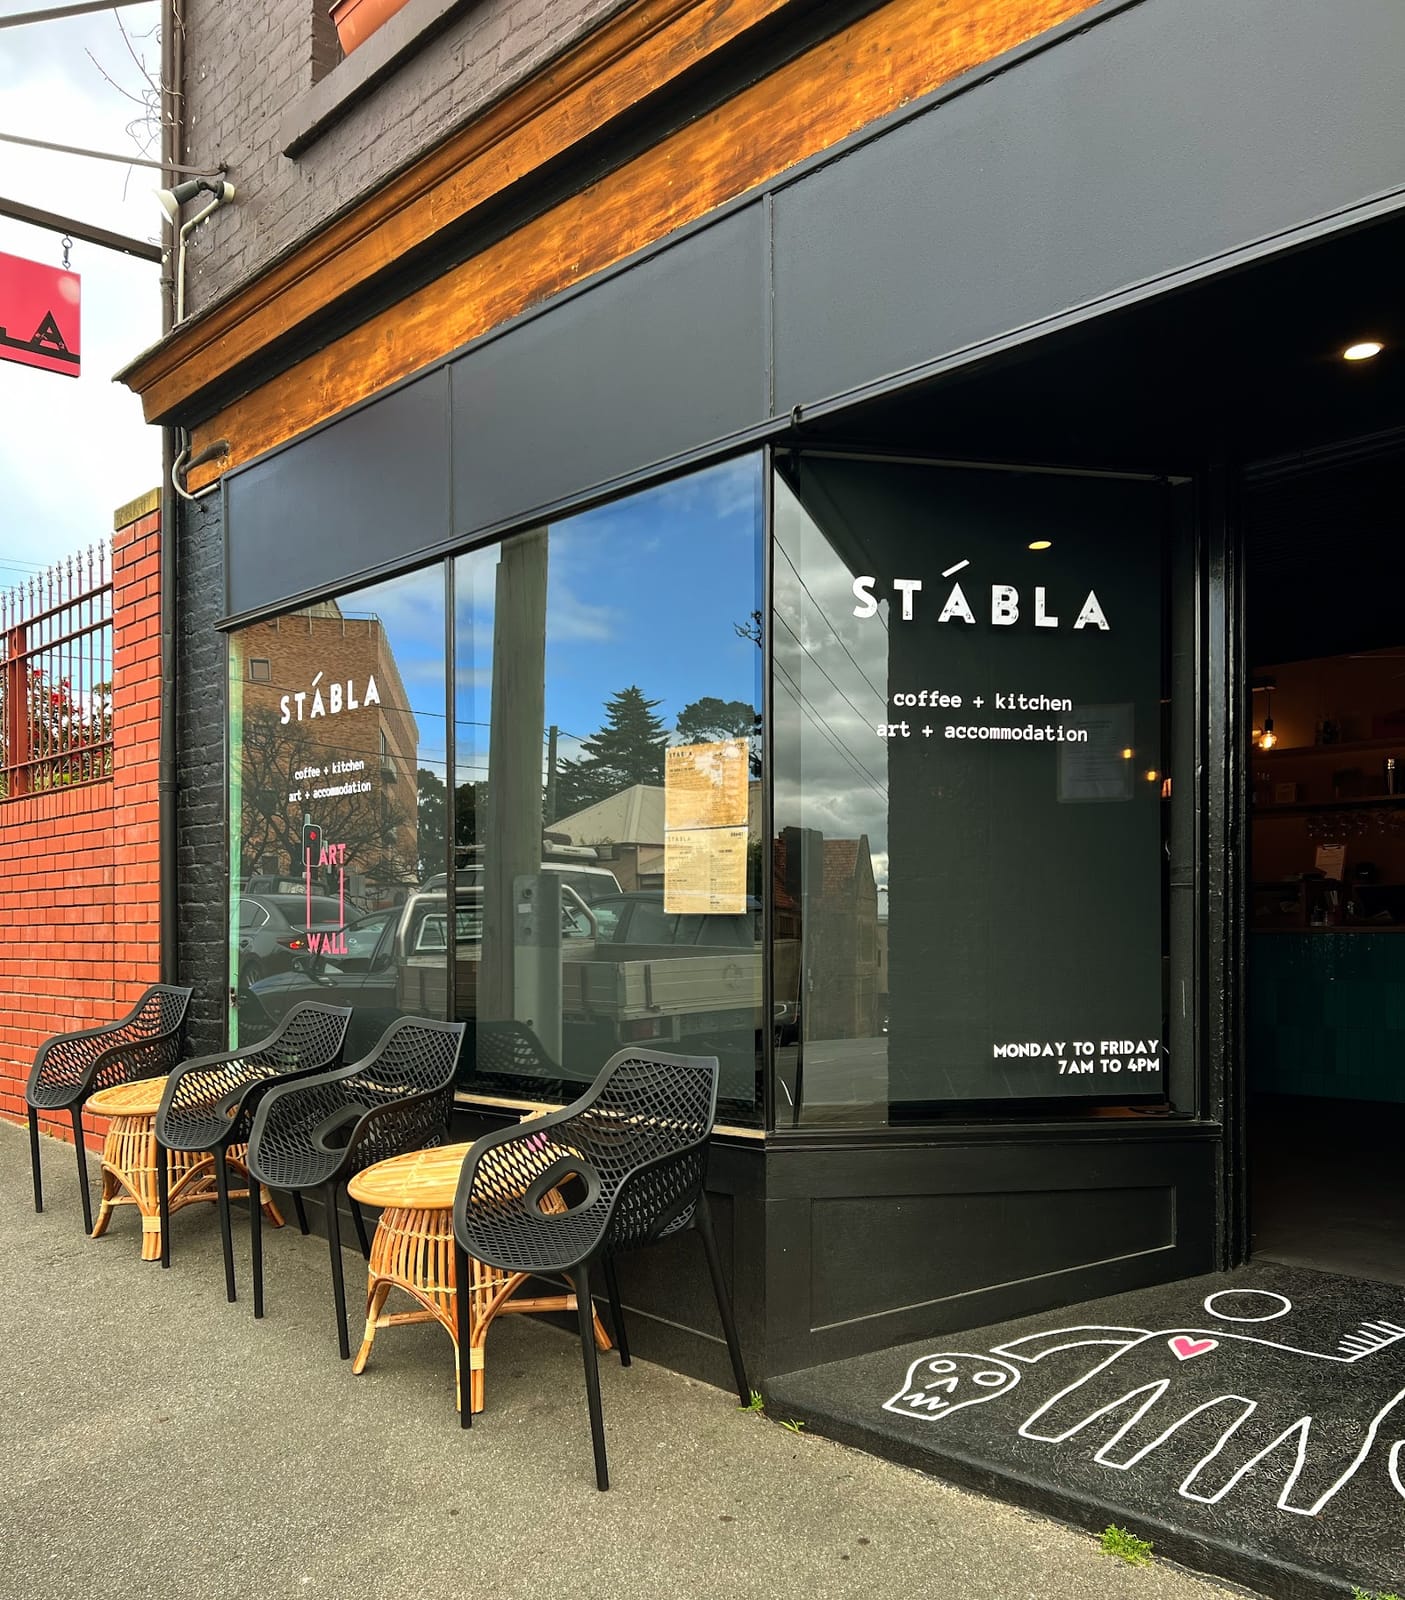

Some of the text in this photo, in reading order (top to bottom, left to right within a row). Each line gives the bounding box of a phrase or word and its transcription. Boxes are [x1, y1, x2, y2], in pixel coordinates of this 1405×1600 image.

[852, 559, 1110, 630] STÁBLA
[280, 671, 381, 725] STÁBLA
[893, 690, 1072, 711] coffee + kitchen
[876, 721, 1088, 742] art + accommodation
[294, 767, 321, 781] coffee
[331, 759, 365, 774] kitchen
[288, 789, 303, 803] art
[313, 780, 372, 800] accommodation
[319, 843, 346, 866] ART
[307, 932, 348, 955] WALL
[993, 1040, 1159, 1058] MONDAY TO FRIDAY
[1058, 1058, 1160, 1075] 7AM TO 4PM
